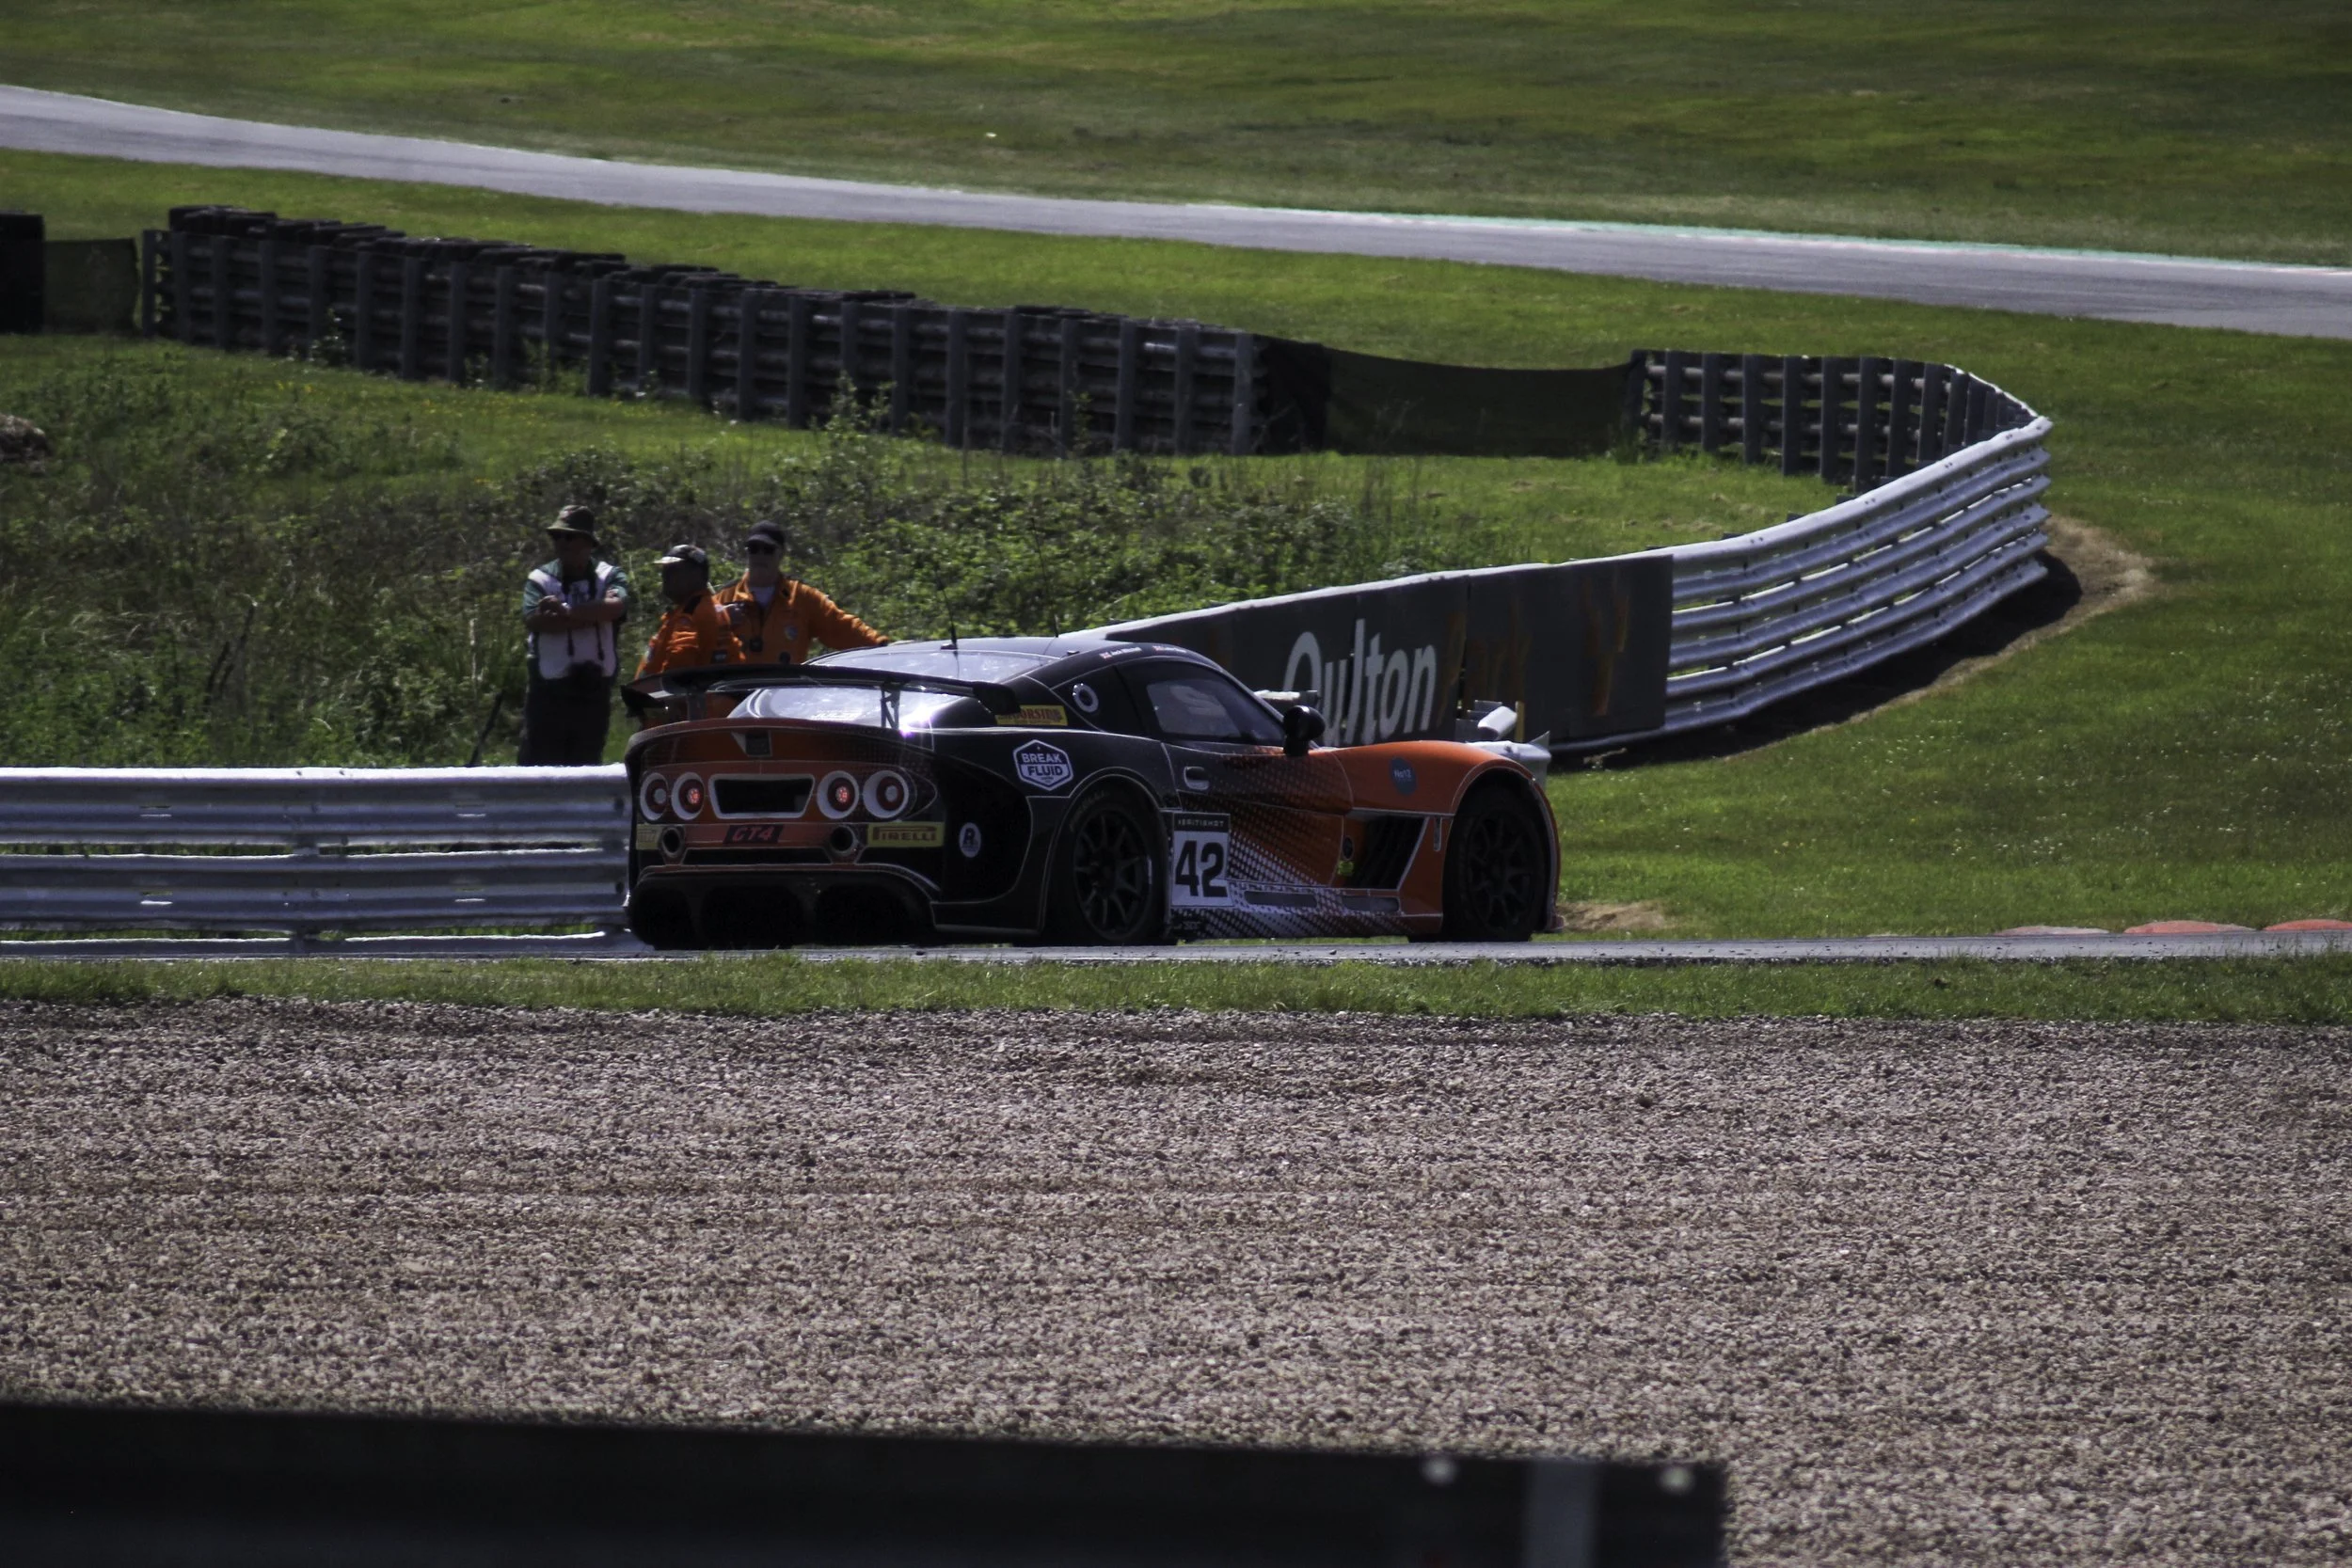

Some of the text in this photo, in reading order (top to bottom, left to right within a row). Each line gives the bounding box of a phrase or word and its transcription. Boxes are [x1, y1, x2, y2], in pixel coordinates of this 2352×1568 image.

[1021, 752, 1062, 763] BREAK
[1027, 766, 1062, 776] FLUID
[732, 826, 774, 843] GT4
[872, 826, 936, 841] PIRELLI
[1175, 841, 1228, 897] 42
